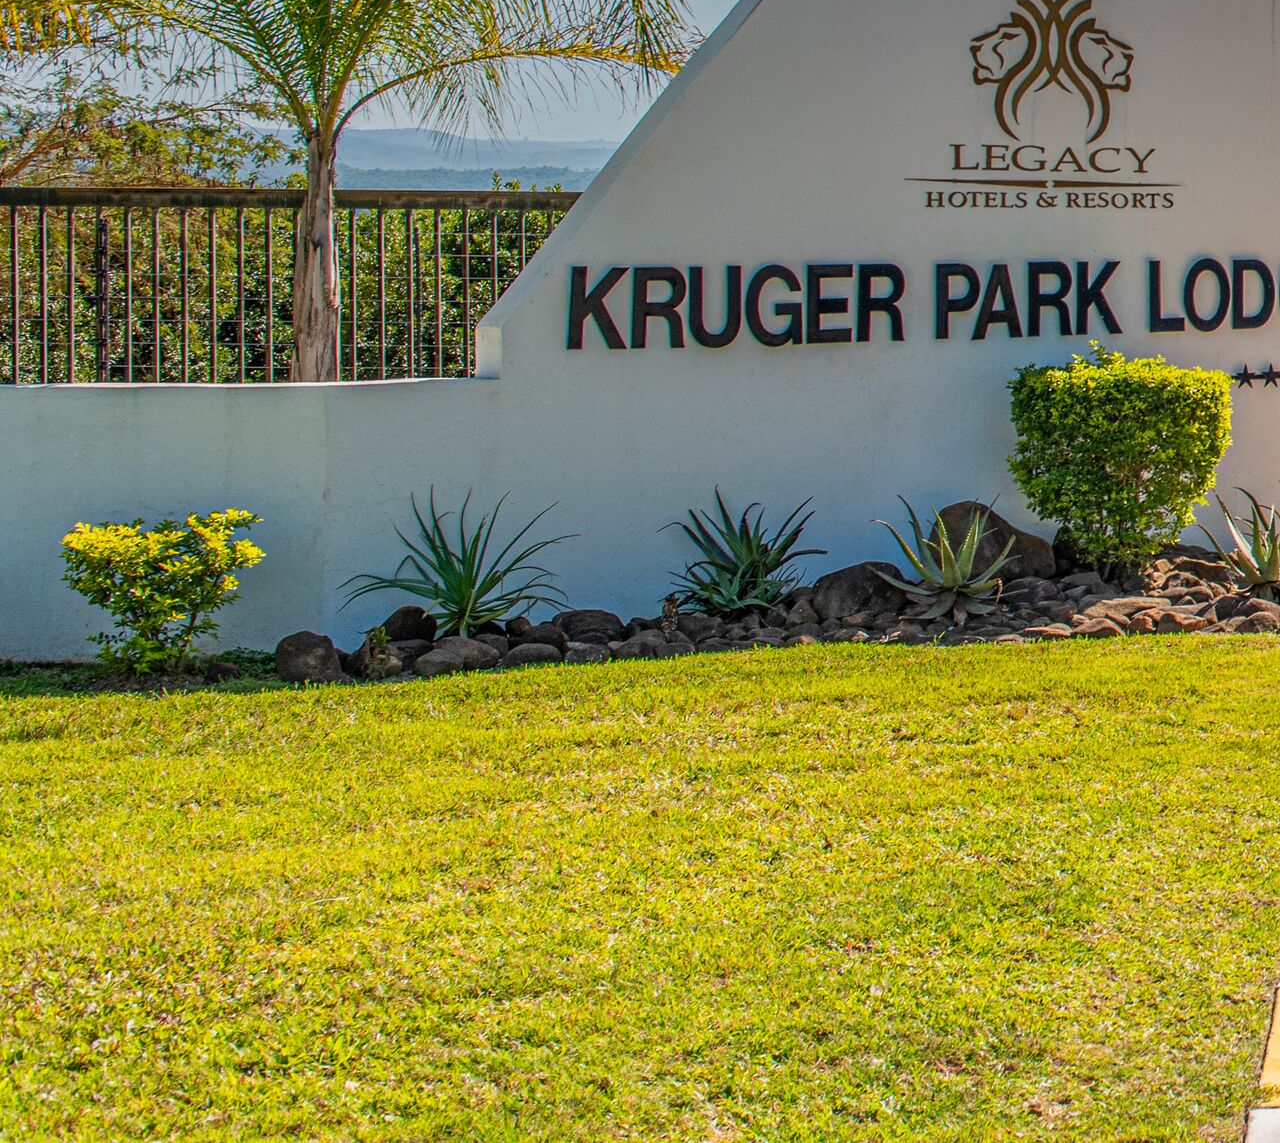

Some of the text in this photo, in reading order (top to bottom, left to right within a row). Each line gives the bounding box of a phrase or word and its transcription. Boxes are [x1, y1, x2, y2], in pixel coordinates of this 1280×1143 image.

[949, 143, 1156, 174] LEGACY
[925, 191, 1175, 210] HOTELS & RESORTS
[564, 263, 906, 352] KRUGER
[934, 260, 1124, 342] PARK
